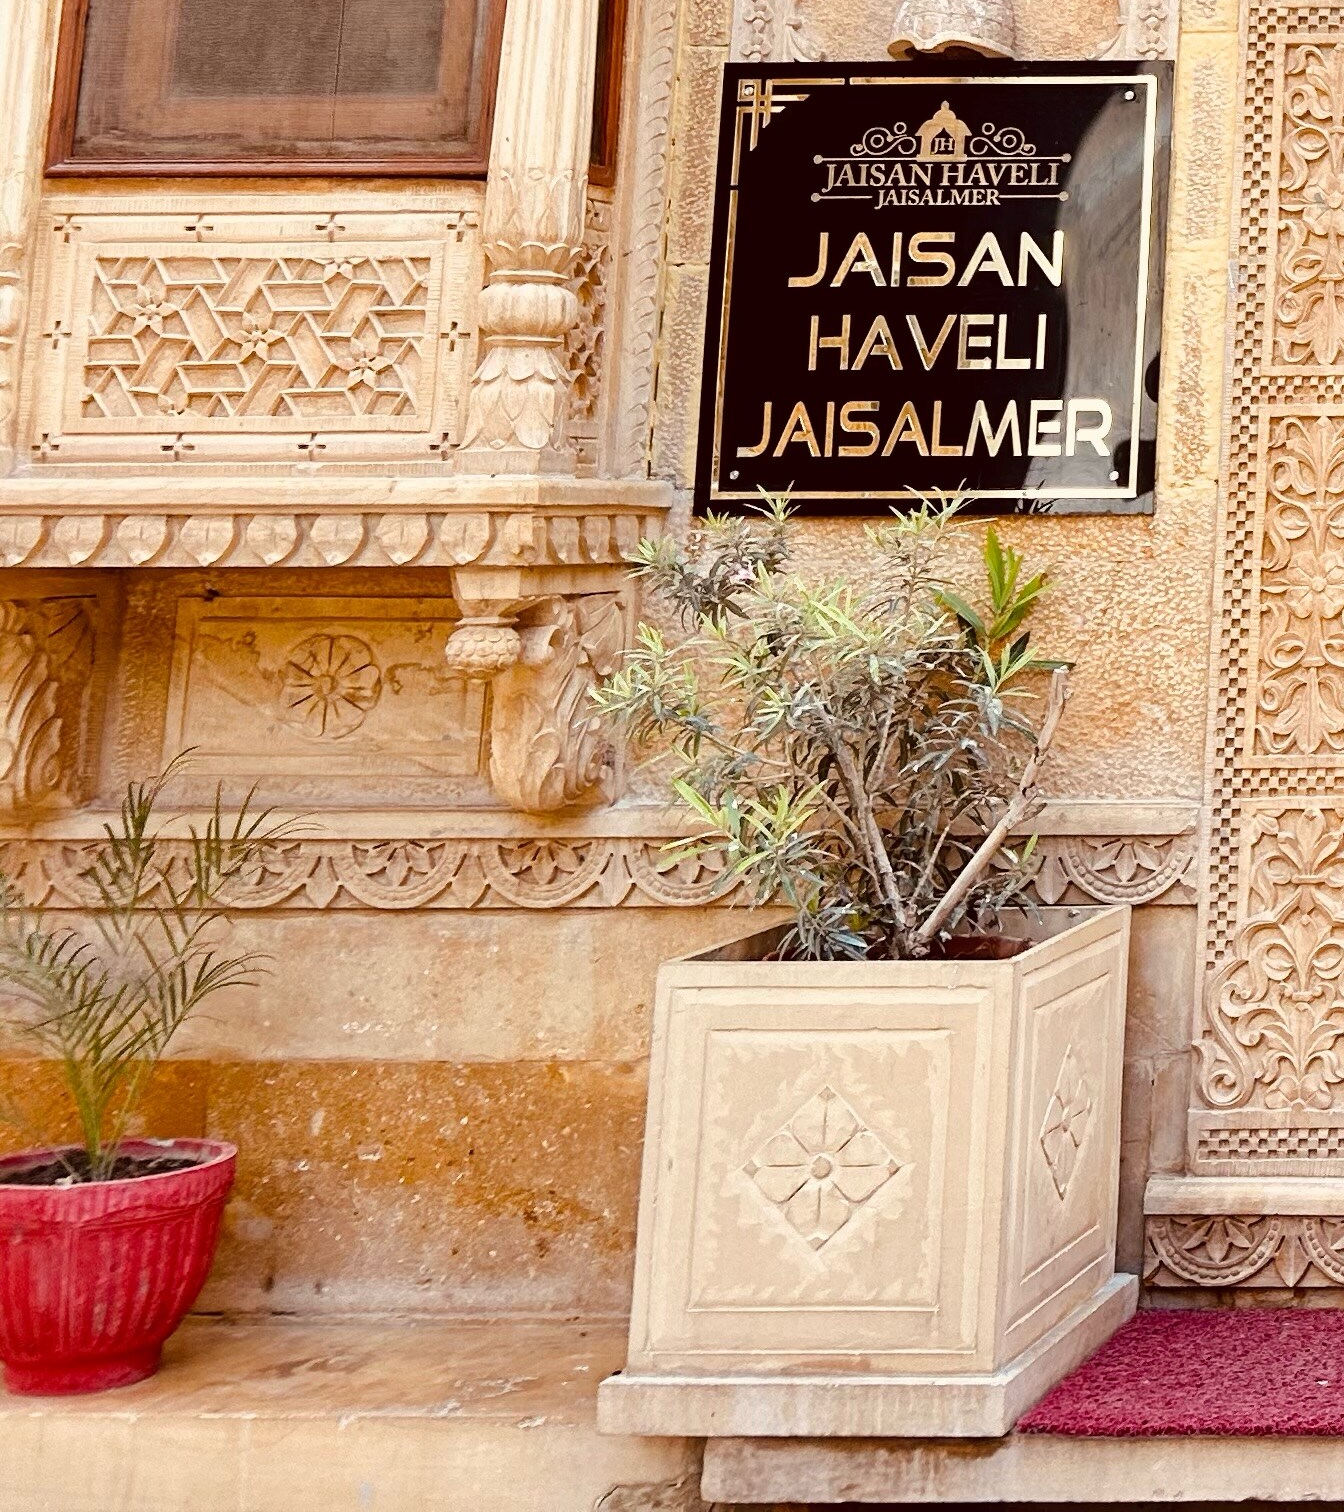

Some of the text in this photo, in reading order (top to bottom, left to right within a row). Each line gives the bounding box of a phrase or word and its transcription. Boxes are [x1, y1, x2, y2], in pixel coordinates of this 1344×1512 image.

[933, 138, 954, 154] JH
[825, 162, 1060, 192] JAISAN HAVELI
[874, 188, 1001, 209] JAISALMER
[788, 230, 1065, 287] JAISAN
[808, 313, 1047, 371] HAVELI
[736, 398, 1113, 457] JAISALMER
